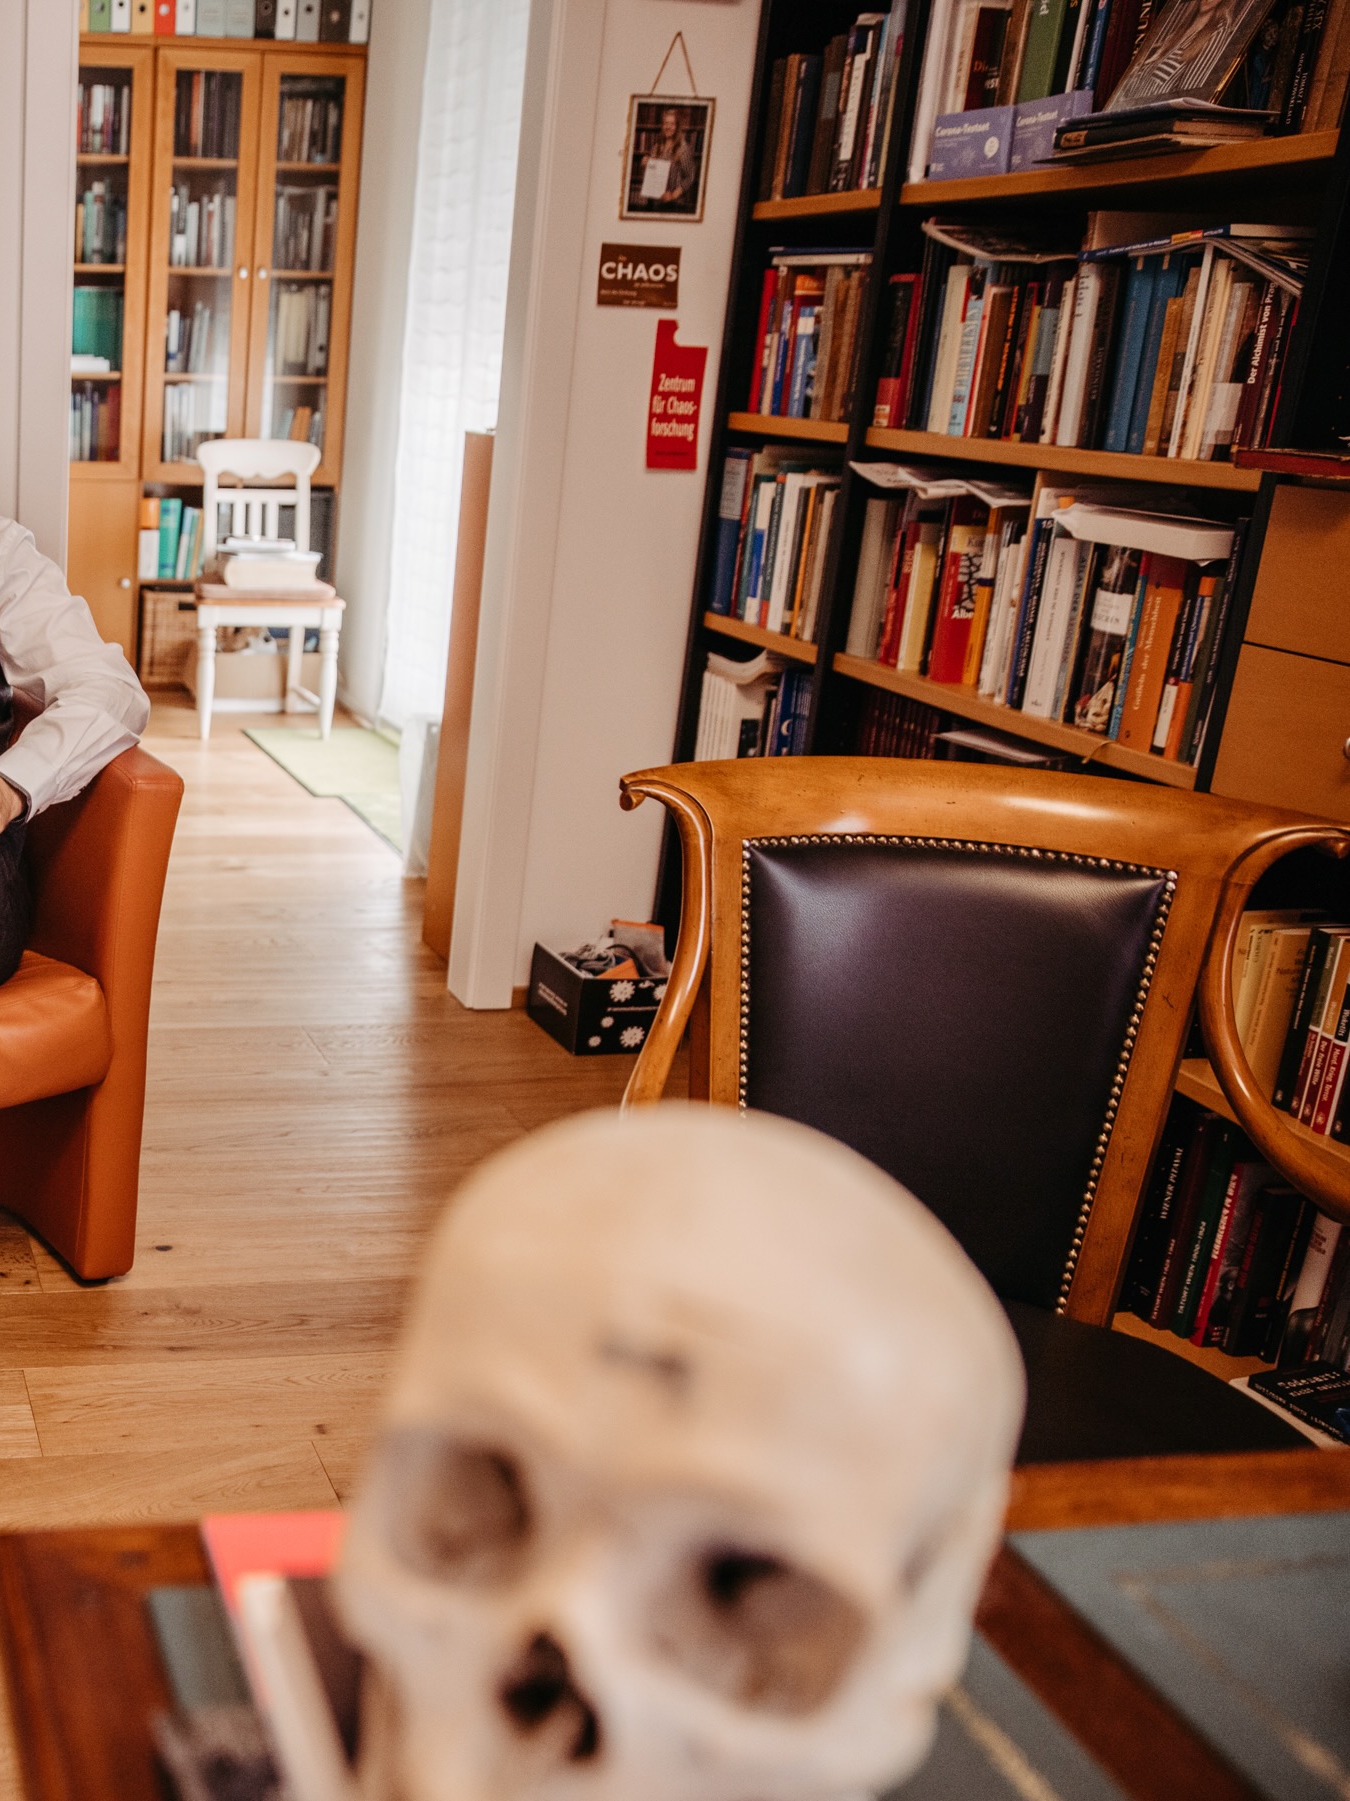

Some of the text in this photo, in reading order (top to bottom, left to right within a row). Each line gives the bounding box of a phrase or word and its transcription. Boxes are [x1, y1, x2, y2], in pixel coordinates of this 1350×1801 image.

[601, 261, 678, 282] CHAOS
[1247, 281, 1277, 385] Der Alchimist von Prag
[658, 373, 696, 393] Zentrum
[652, 394, 698, 415] für Chaos-
[650, 417, 695, 442] forschung
[1337, 1008, 1350, 1037] Wuketits
[1312, 1040, 1327, 1086] Der freie Wille
[1159, 1147, 1184, 1219] WIENER PITAVAL
[1151, 1276, 1167, 1319] TATORT WIEN
[1177, 1286, 1190, 1314] TATORT
[1185, 1263, 1196, 1285] WIEN
